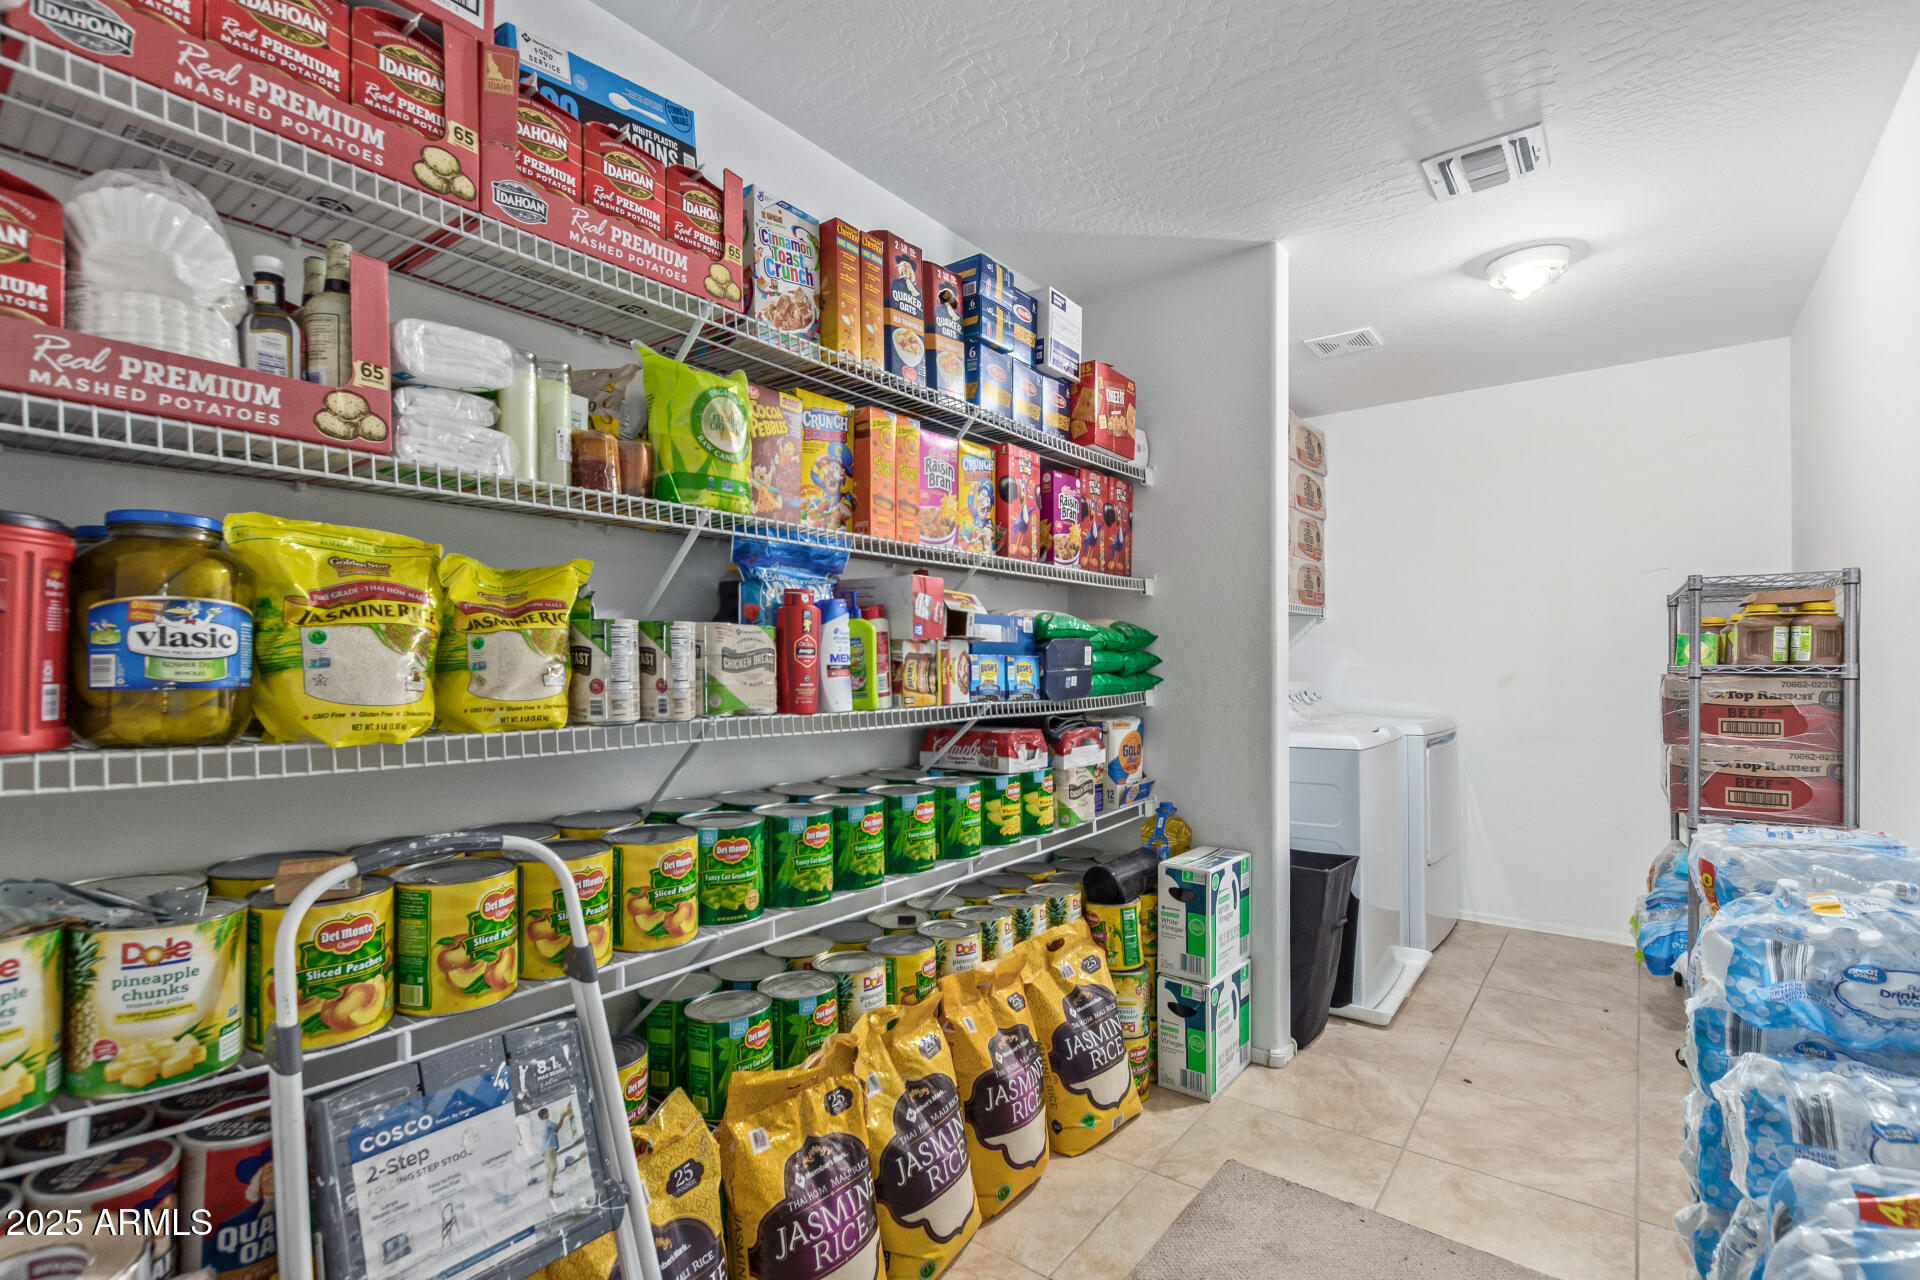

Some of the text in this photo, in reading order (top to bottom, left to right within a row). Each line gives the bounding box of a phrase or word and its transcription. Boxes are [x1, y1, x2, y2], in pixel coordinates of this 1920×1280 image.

[37, 0, 130, 44] IDAHOAN
[221, 16, 257, 42] Real
[260, 34, 341, 83] PREMIUM
[220, 34, 341, 94] MASHED POTATOES
[528, 54, 561, 74] SERVICE
[178, 40, 386, 151] Real PREMIUM
[365, 81, 394, 106] Real
[174, 71, 385, 167] MASHED POTATOES
[364, 98, 410, 122] MASHED
[453, 124, 475, 147] 65
[632, 122, 678, 151] WHITE PLASTIC
[523, 155, 577, 189] PREMIUM
[603, 160, 654, 190] IDAHOAN
[536, 173, 577, 196] POTATOES
[494, 189, 546, 216] IDAHOAN
[594, 185, 660, 223] Real PREMIUM
[594, 198, 661, 232] MASHED POTATOES
[674, 220, 693, 237] Real
[571, 207, 689, 272] Real PREMIUM
[674, 233, 701, 252] MASHED
[759, 226, 814, 257] Cinnamon
[569, 230, 688, 286] MASHED POTATOES
[728, 244, 741, 261] 65
[771, 245, 806, 270] Toast
[765, 256, 815, 288] Crunch
[892, 290, 922, 312] QUAKER
[899, 301, 917, 316] OATS
[936, 316, 963, 333] QUAKER
[942, 327, 958, 340] OATS
[33, 333, 112, 374] Real
[118, 355, 282, 409] PREMIUM
[360, 362, 385, 381] 65
[29, 368, 281, 427] MASHED POTATOES
[802, 410, 849, 432] CRUNCH
[924, 458, 955, 479] Raisin
[928, 473, 952, 492] Bran
[1059, 494, 1079, 510] Raisin
[1061, 506, 1077, 521] Bran
[296, 604, 393, 626] JASMINE
[466, 614, 540, 631] JASMINE
[136, 625, 232, 648] vlasic
[980, 663, 998, 673] BUSH'S
[1016, 664, 1032, 674] BUSH'S
[1727, 689, 1815, 702] Top Ramen
[327, 711, 346, 719] Free
[1727, 707, 1767, 719] BEEF
[352, 723, 364, 731] NET
[1123, 744, 1141, 757] GOLD
[1734, 761, 1822, 773] Top Ramen
[1735, 777, 1773, 789] BEEF
[663, 860, 675, 870] Del
[584, 873, 604, 887] Monte
[705, 873, 721, 882] Fancy
[654, 888, 676, 898] Sliced
[484, 900, 496, 913] Del
[586, 903, 609, 917] Peaches
[1160, 917, 1179, 926] White
[1160, 923, 1185, 933] Vinegar
[319, 922, 374, 945] Del Monte
[473, 932, 499, 947] Sliced
[121, 937, 193, 966] Dole
[955, 941, 977, 957] Dole
[305, 954, 383, 982] Sliced Peaches
[1085, 957, 1098, 970] 25
[112, 966, 200, 991] pineapple
[121, 984, 189, 1002] chunks
[1010, 993, 1022, 1008] 25
[1064, 1014, 1123, 1061] JASMIN
[1160, 1031, 1179, 1041] White
[1160, 1036, 1185, 1049] Vinegar
[1089, 1036, 1125, 1070] RICE
[828, 1089, 845, 1108] 25
[1011, 1085, 1042, 1126] RICE
[930, 1108, 950, 1122] MALI
[359, 1115, 433, 1153] COSCO
[895, 1109, 964, 1187] JASMIN
[366, 1147, 431, 1184] 2-Step
[416, 1162, 440, 1179] STEP
[673, 1162, 694, 1189] 25
[925, 1138, 968, 1193] RICE
[787, 1195, 807, 1213] THAI
[807, 1184, 829, 1203] HOM
[776, 1171, 875, 1261] JASMIN
[812, 1210, 872, 1272] RICE
[691, 1251, 715, 1272] RICE
